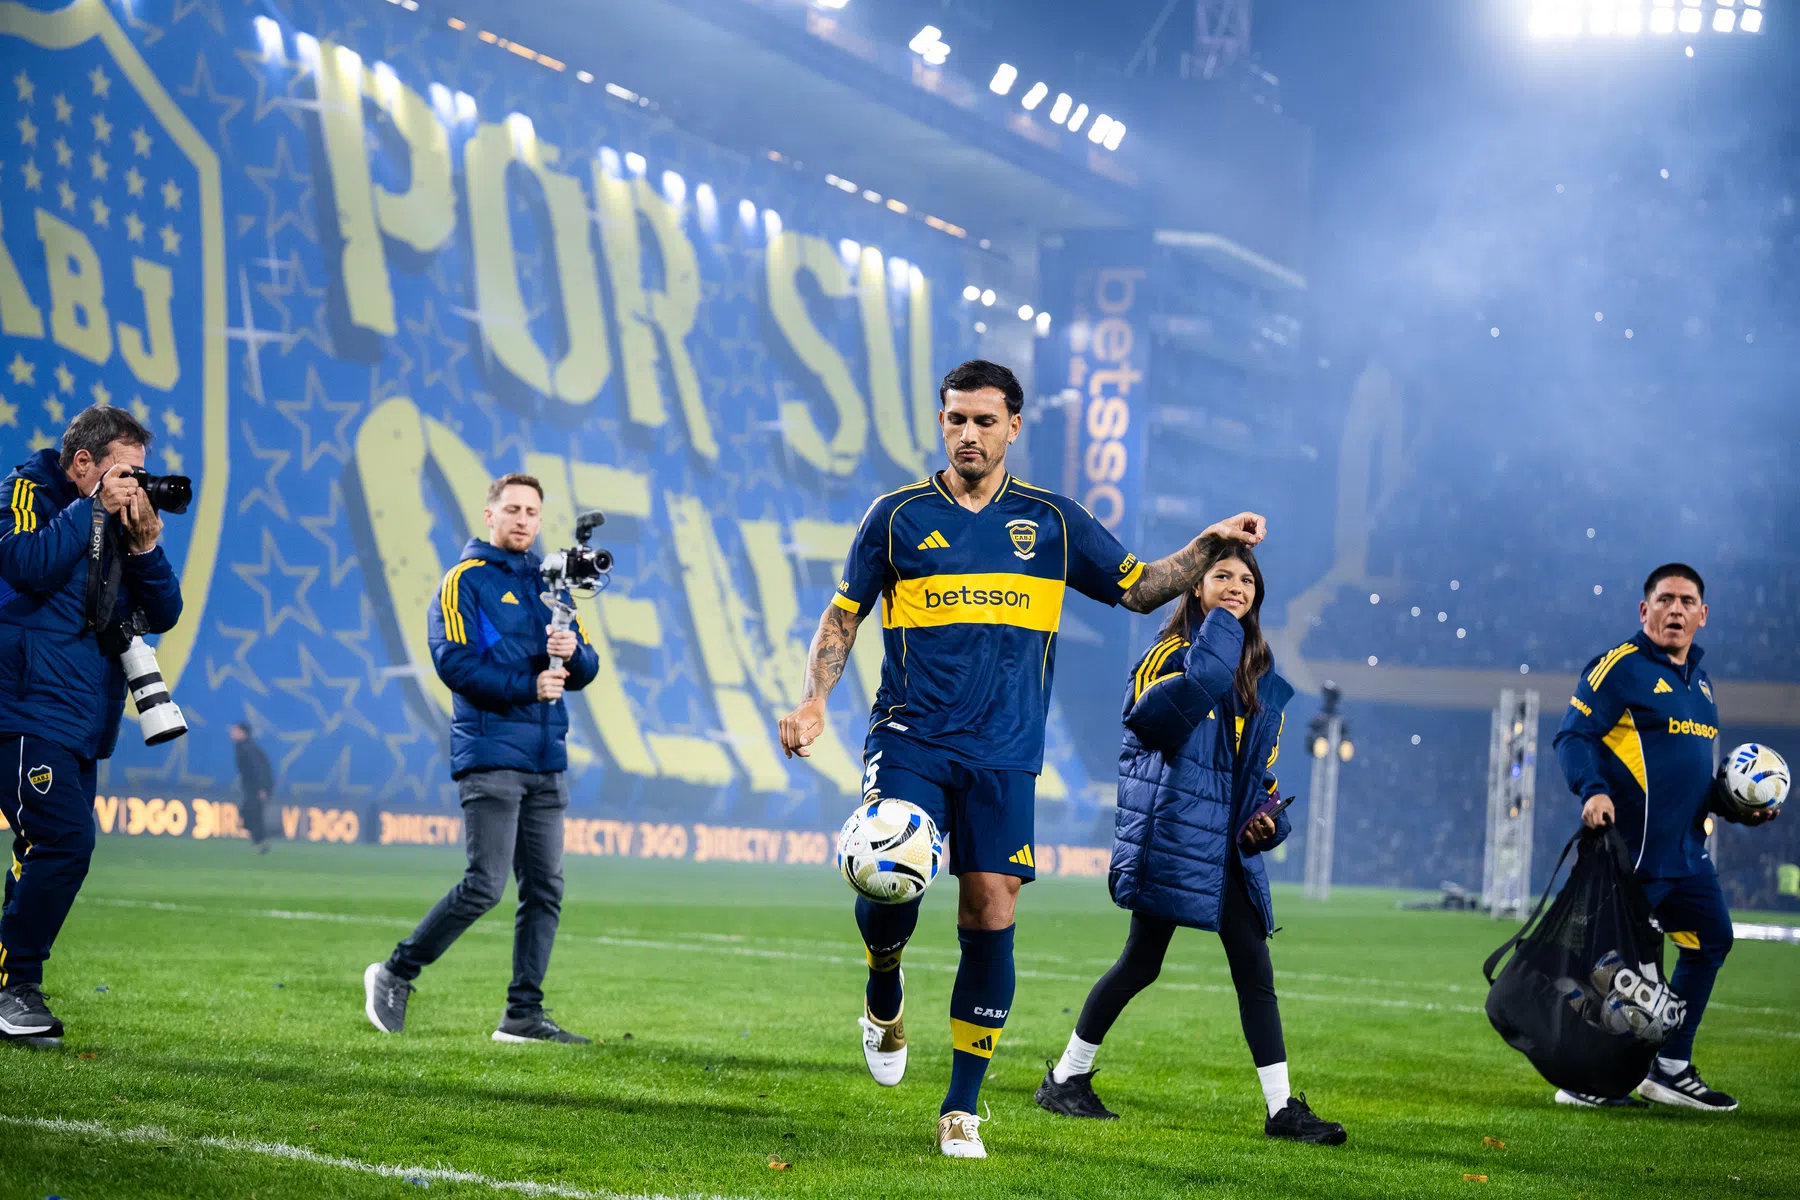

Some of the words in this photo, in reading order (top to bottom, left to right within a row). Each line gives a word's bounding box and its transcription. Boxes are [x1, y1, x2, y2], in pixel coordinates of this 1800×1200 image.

[317, 40, 719, 462] POR
[765, 229, 938, 480] SU
[1084, 268, 1147, 533] betsso
[92, 526, 102, 561] SONY
[924, 584, 1031, 611] betsson
[32, 774, 49, 784] CABJ
[973, 1006, 1008, 1019] CABJ
